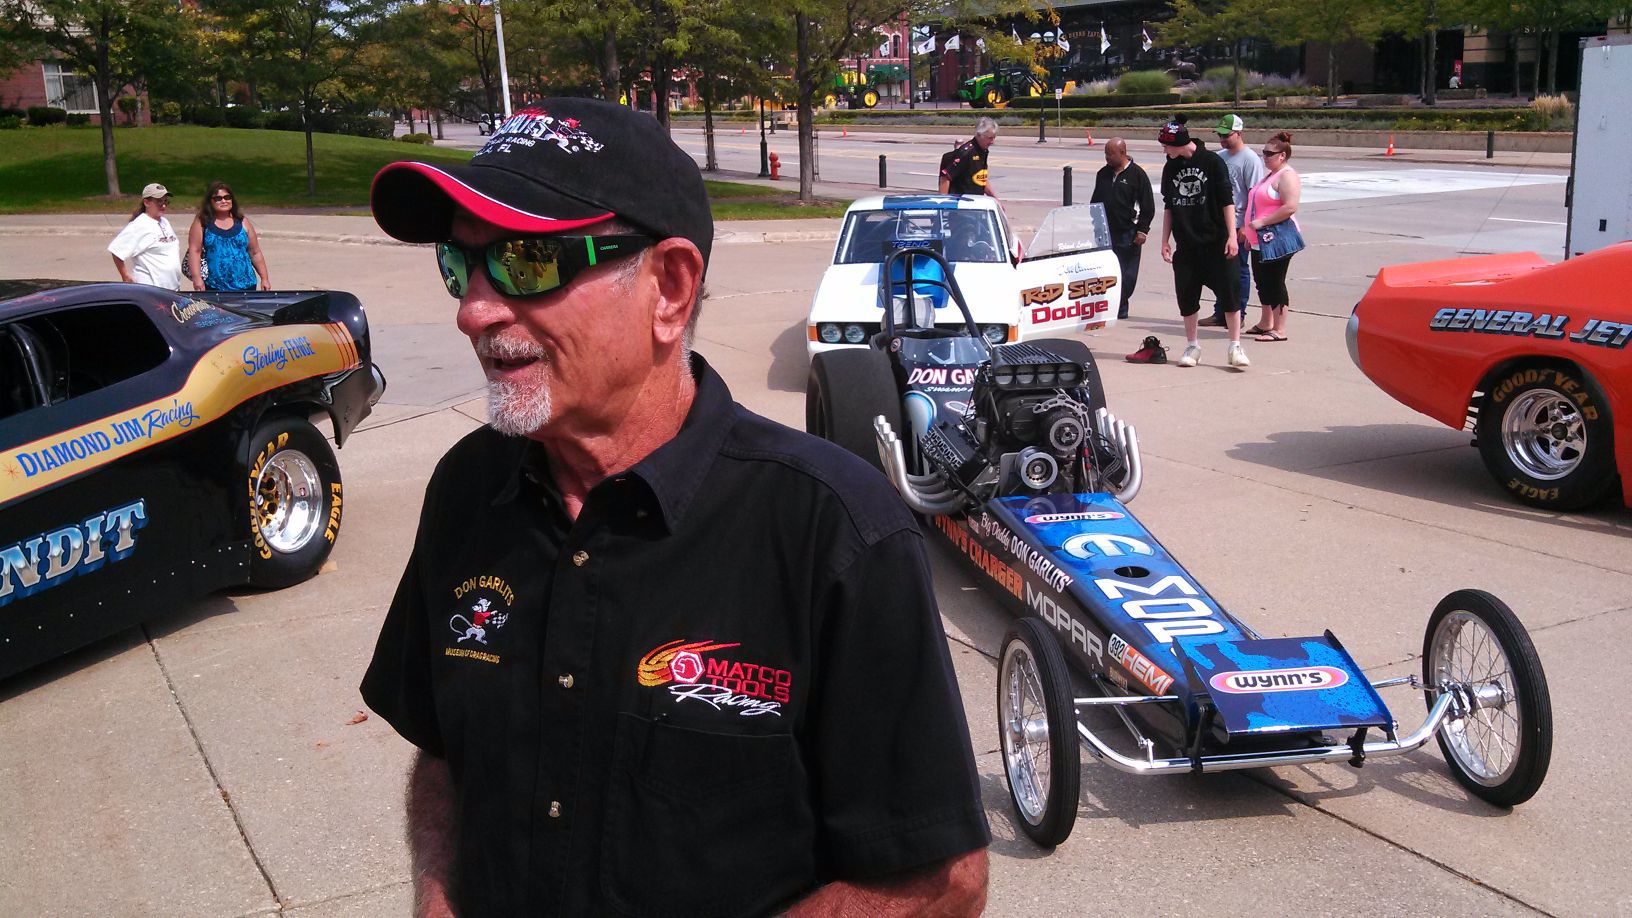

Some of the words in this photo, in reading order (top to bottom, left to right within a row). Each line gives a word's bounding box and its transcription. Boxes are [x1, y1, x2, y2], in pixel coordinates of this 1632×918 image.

[1172, 167, 1208, 187] AMERICAN
[1172, 197, 1195, 206] EAGLE
[1021, 282, 1064, 307] ROD
[1031, 300, 1109, 325] Dodge
[1430, 307, 1570, 340] GENERAL
[1569, 318, 1632, 349] JET
[243, 343, 288, 376] Sterling
[283, 336, 316, 361] FENCE
[907, 367, 947, 385] DON
[1492, 368, 1599, 422] GOODYEAR
[15, 430, 111, 478] DIAMOND
[110, 417, 147, 446] JIM
[142, 399, 200, 438] Racing
[324, 482, 342, 544] EAGLE
[981, 512, 991, 537] Big
[992, 521, 1011, 551] Daddy
[1010, 535, 1029, 564] DON
[969, 537, 1023, 601] CHARGER
[453, 577, 477, 600] DON
[478, 575, 515, 606] GARLITS
[1026, 581, 1104, 668] MOPAR
[707, 658, 792, 687] MATCO
[1109, 637, 1125, 660] 392
[1122, 647, 1171, 695] HEMI
[1234, 671, 1323, 688] wynn's
[668, 683, 782, 716] Racing
[706, 674, 790, 704] TOOLS
